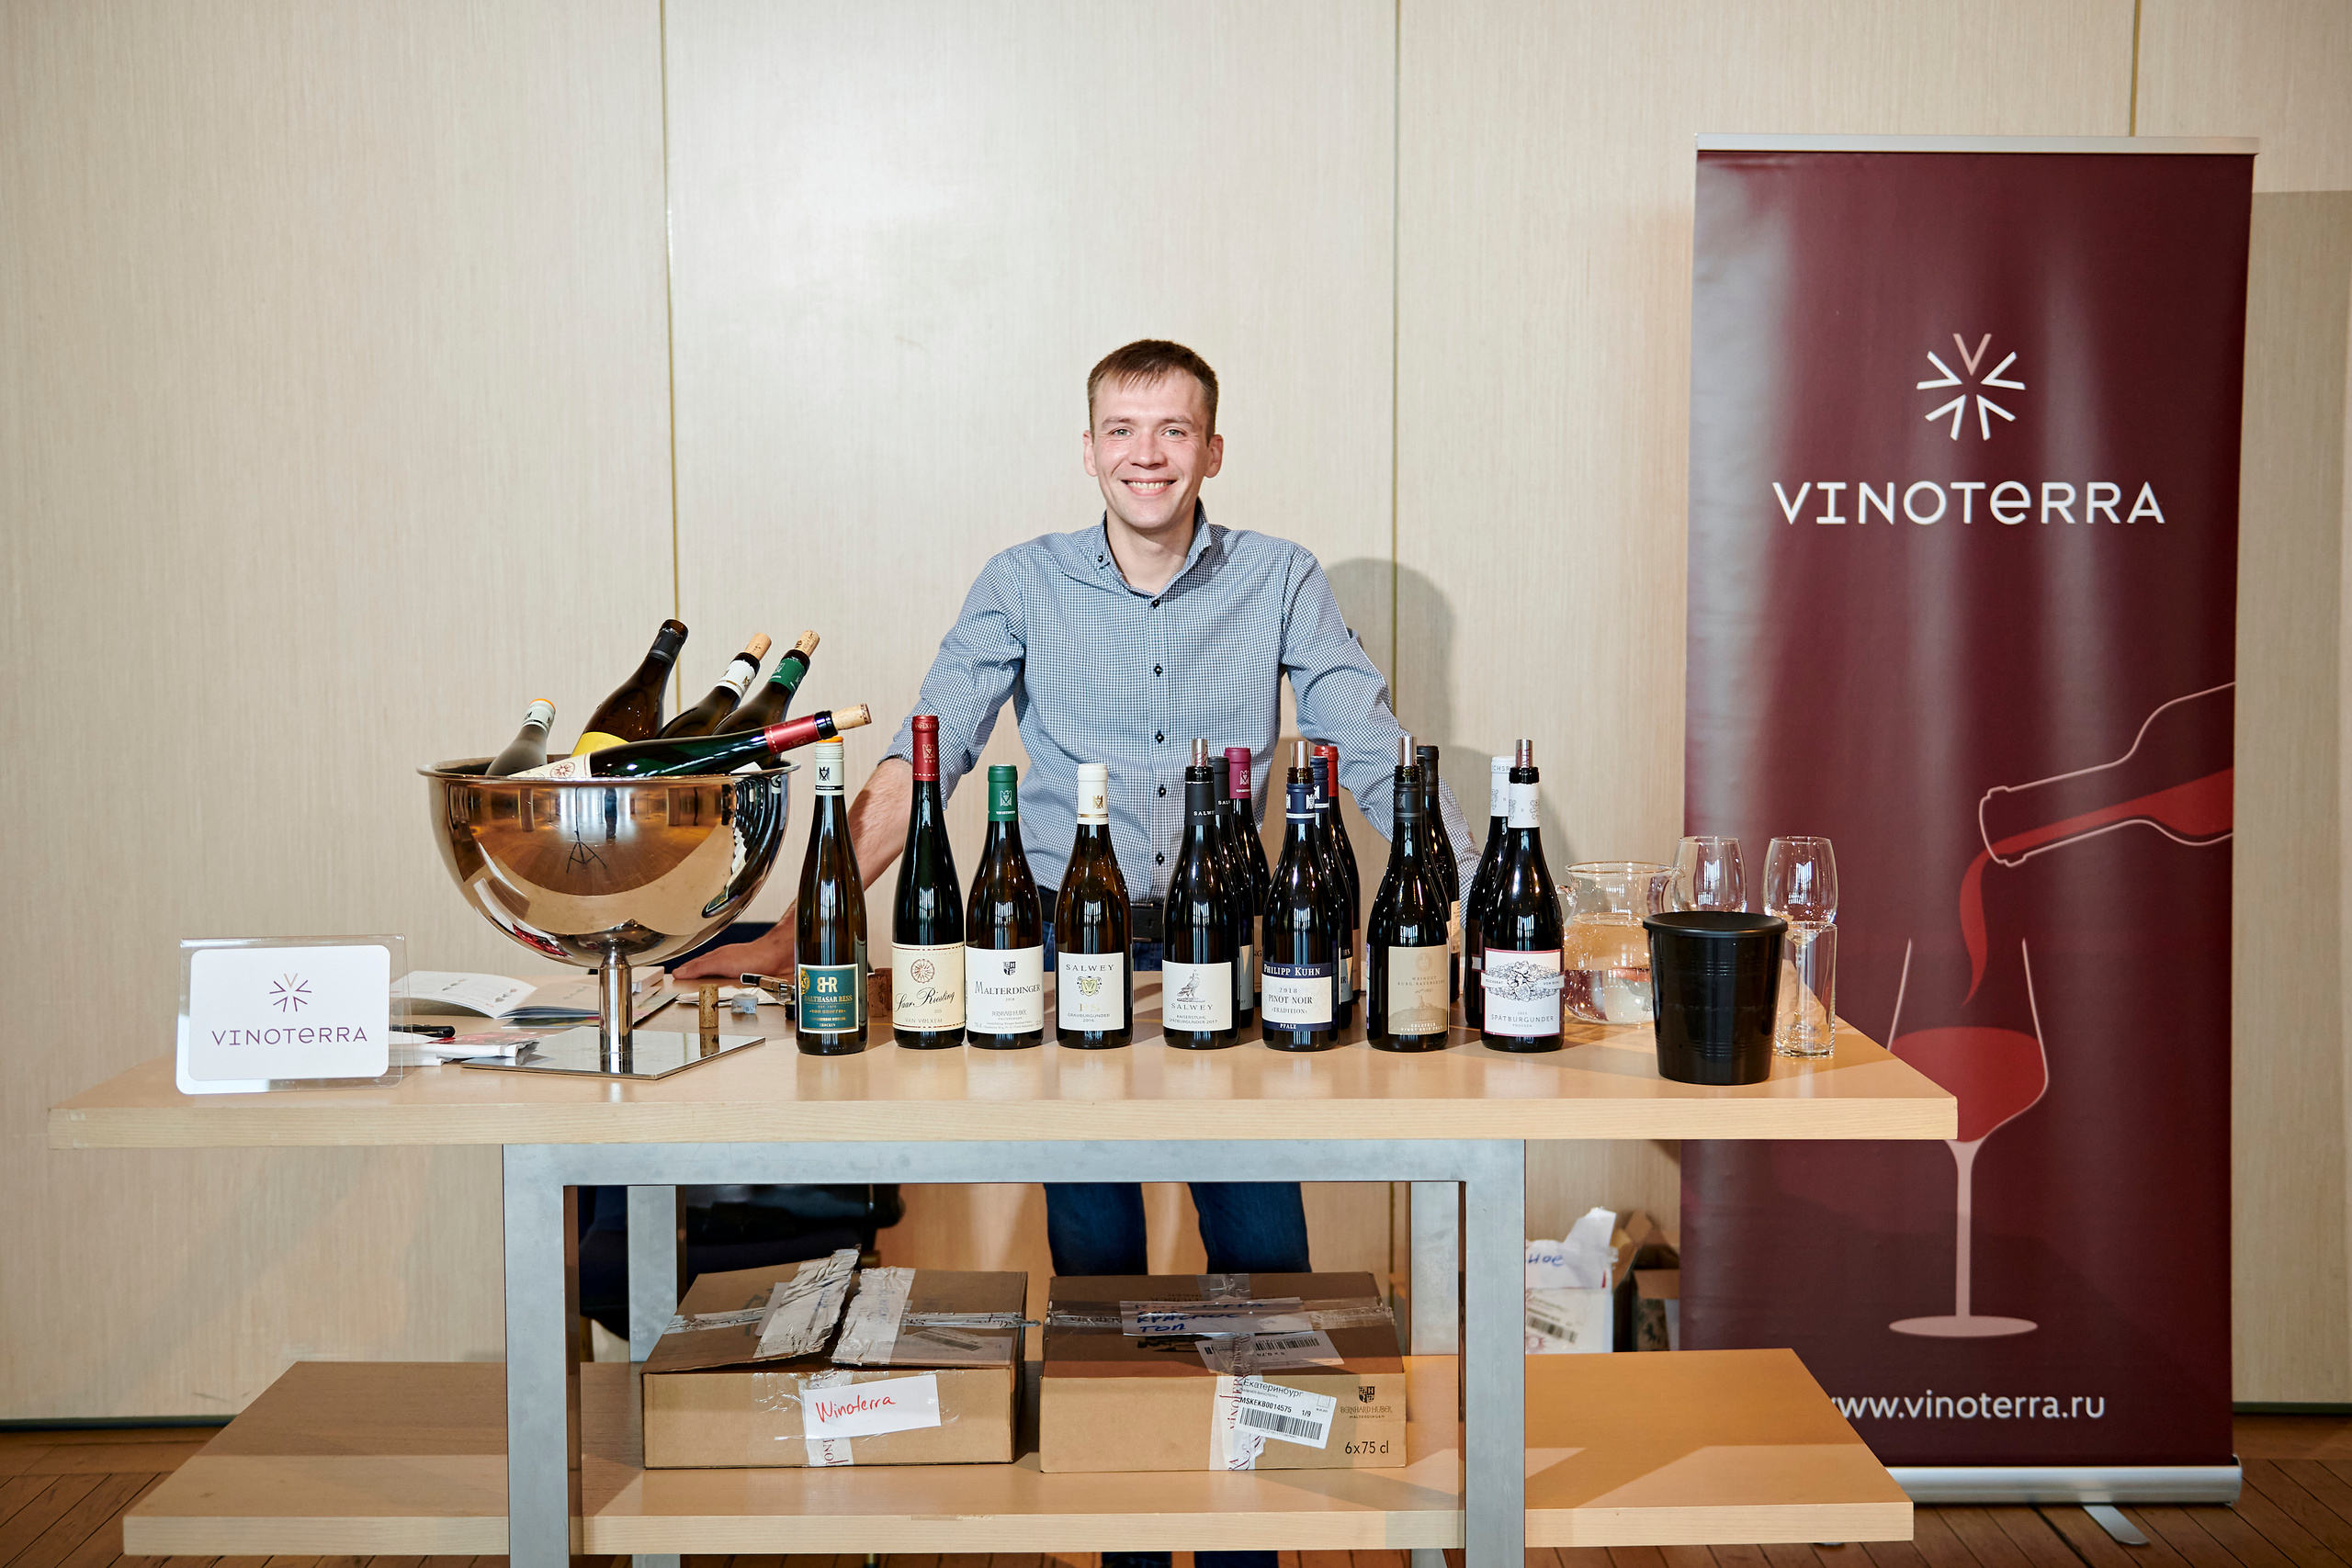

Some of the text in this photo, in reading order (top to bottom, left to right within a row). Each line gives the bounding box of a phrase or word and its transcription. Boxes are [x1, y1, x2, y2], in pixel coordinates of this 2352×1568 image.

[1263, 964, 1321, 976] PHILIPP KUHN
[975, 980, 1041, 995] MALTERDINGER
[1268, 994, 1313, 1004] PINOT NOIR
[1491, 1014, 1555, 1023] SPÄTBURGUNDER
[816, 1394, 897, 1423] Winoterra
[1239, 1396, 1292, 1414] MSKEKB0014575
[1830, 1389, 2105, 1418] ww.vinoterra.ru
[1301, 1409, 1312, 1417] 1/9
[1340, 1406, 1371, 1415] BERNHARD
[1380, 1439, 1389, 1453] cl
